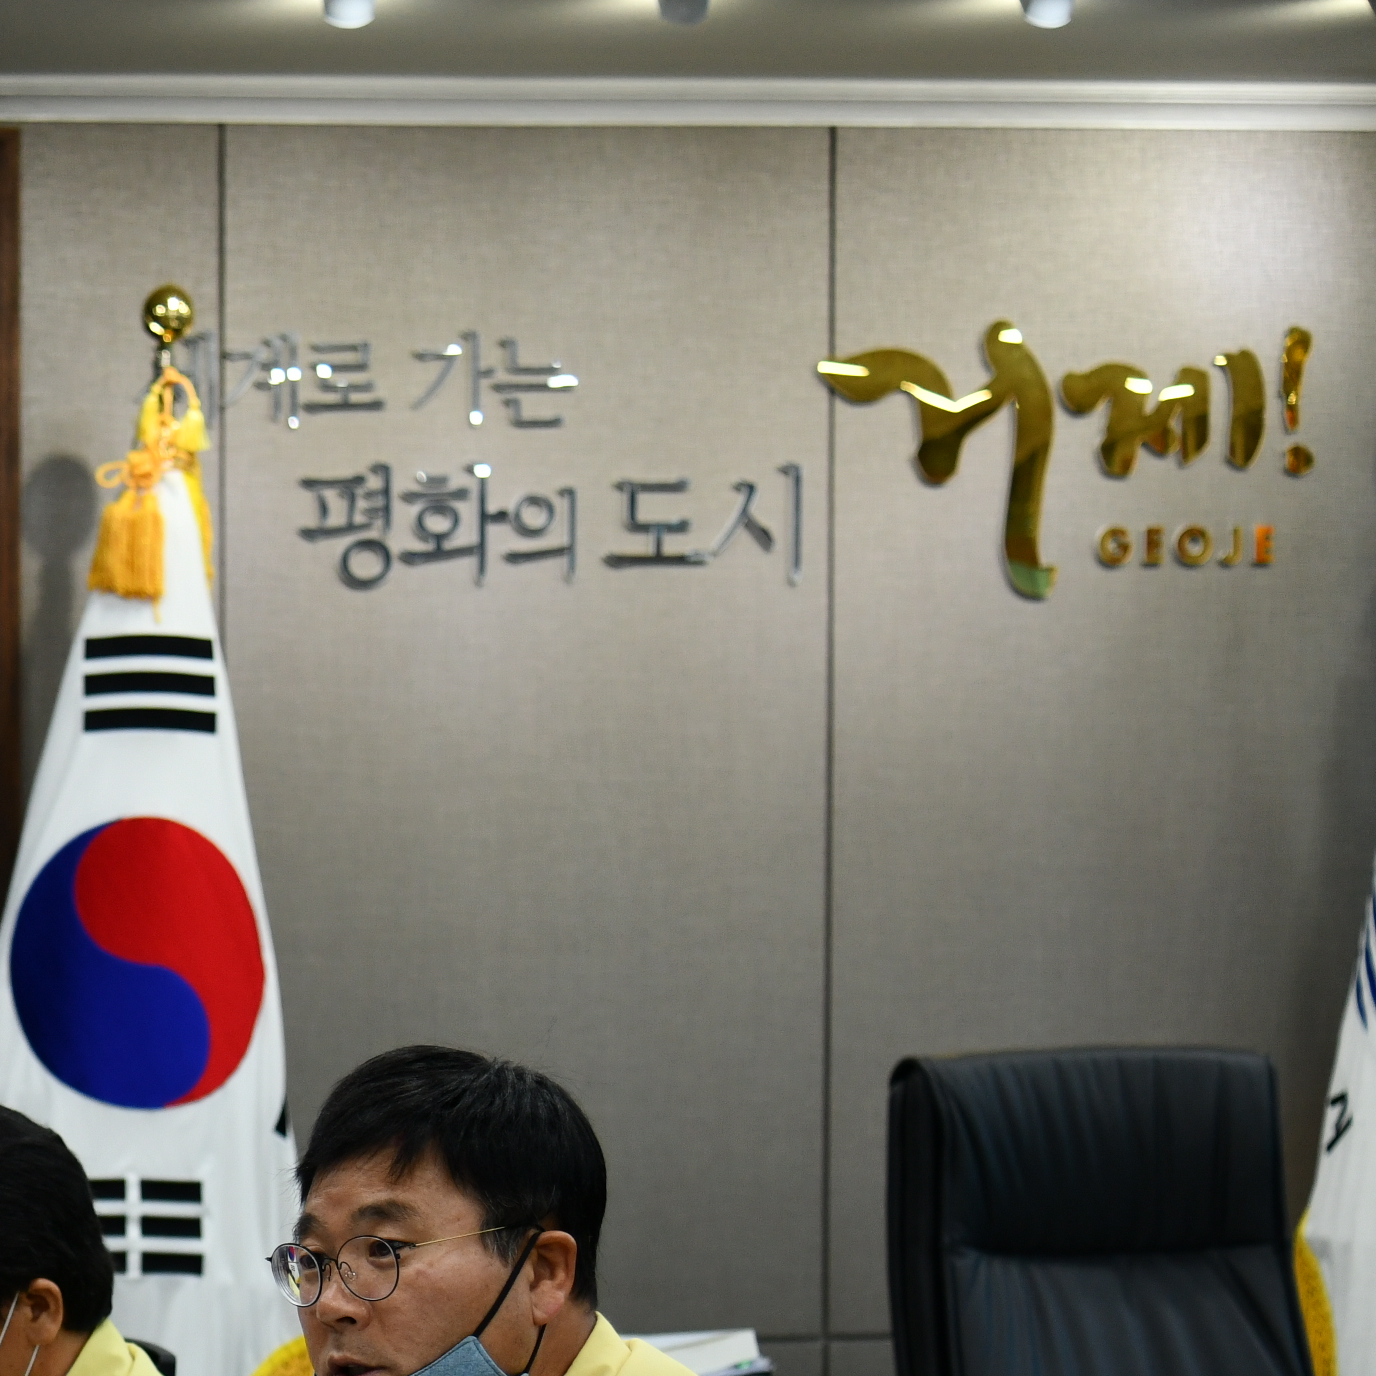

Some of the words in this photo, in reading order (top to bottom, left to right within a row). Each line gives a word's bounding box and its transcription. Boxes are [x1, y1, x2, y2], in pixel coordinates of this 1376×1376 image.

[411, 328, 580, 430] 가는
[297, 460, 578, 590] 평화의
[601, 462, 806, 588] 도시
[1099, 525, 1276, 567] GEOJE
